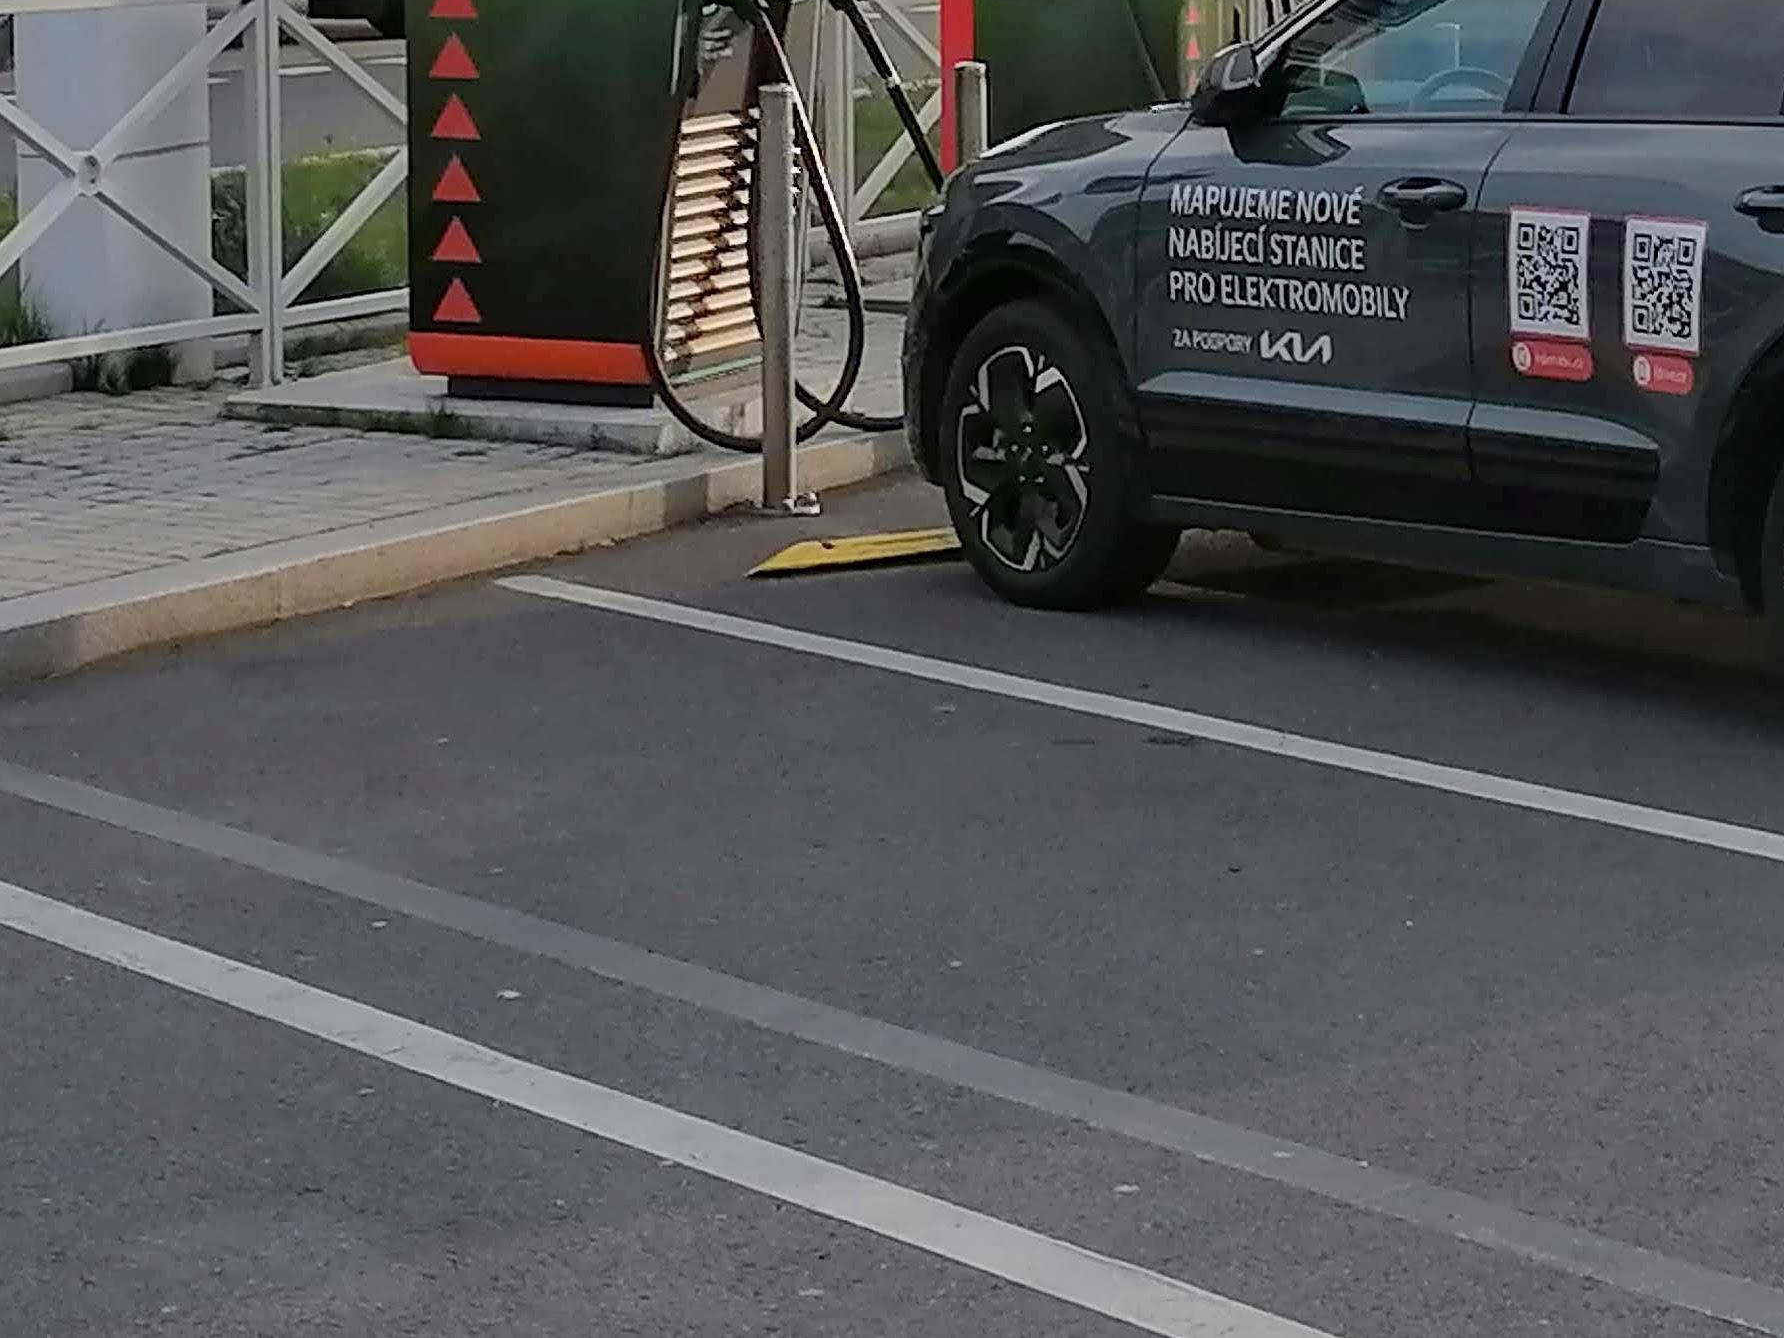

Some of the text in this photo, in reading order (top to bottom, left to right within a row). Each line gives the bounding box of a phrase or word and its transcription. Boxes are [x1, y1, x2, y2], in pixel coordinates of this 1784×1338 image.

[1170, 183, 1364, 224] MAPUJEME NOVÉ
[1169, 223, 1366, 270] NABÍJECÍ STANICE
[1169, 270, 1410, 320] PRO ELEKTROMOBILY
[1172, 329, 1192, 347] ZA
[1193, 330, 1253, 353] PODPORY
